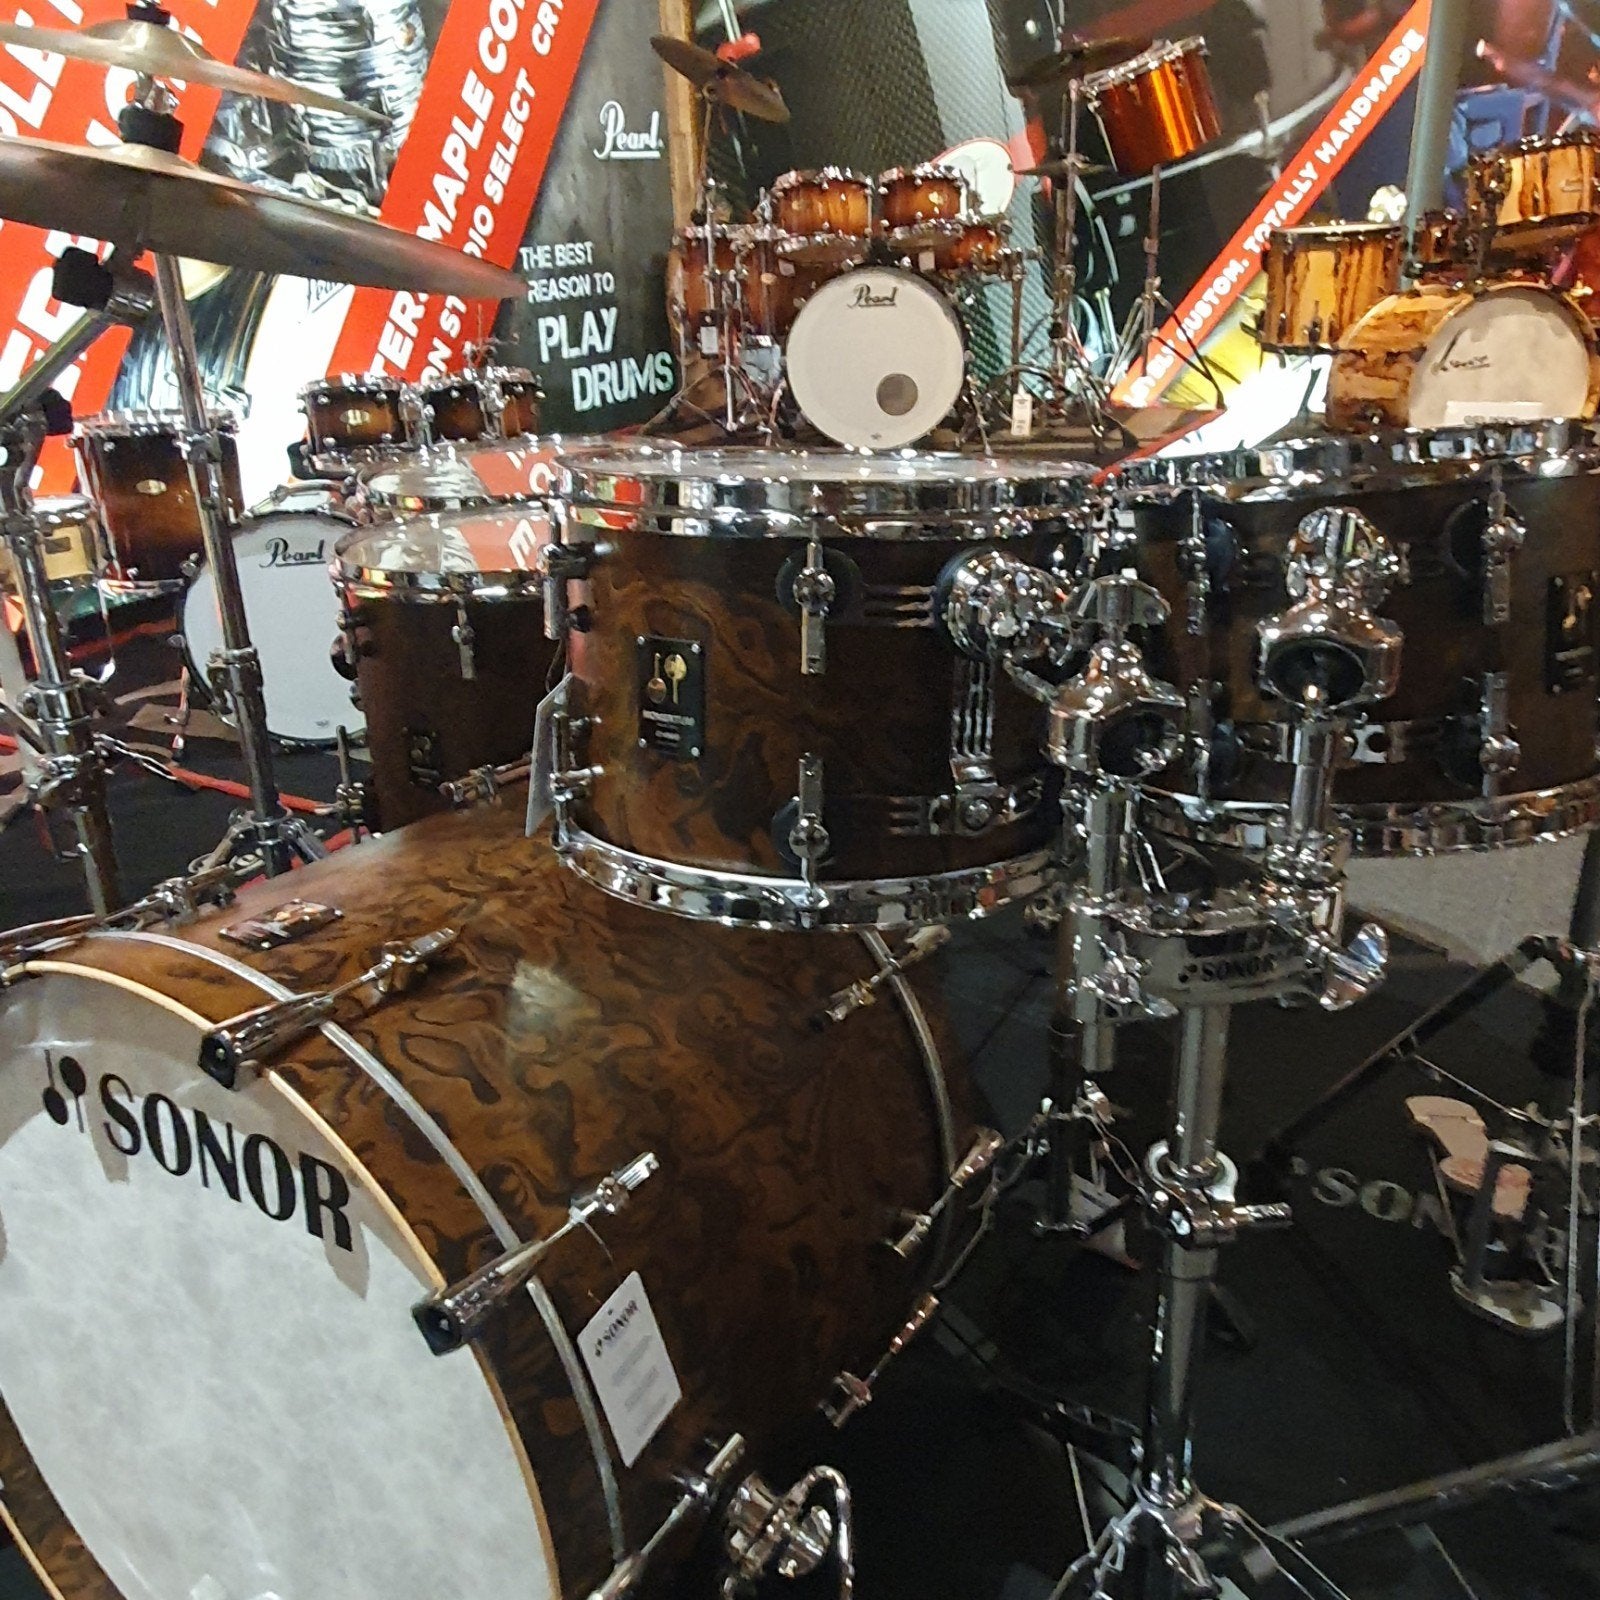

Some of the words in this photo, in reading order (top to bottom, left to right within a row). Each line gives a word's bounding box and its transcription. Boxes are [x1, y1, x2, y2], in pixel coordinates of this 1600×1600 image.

[416, 69, 495, 242] MAPLE
[478, 0, 526, 74] CO
[483, 67, 536, 205] SELECT
[531, 0, 565, 56] CR
[593, 100, 661, 160] Pearl
[1243, 160, 1319, 254] TOTALLY
[1314, 28, 1426, 165] HANDMADE
[519, 246, 554, 271] THE
[554, 240, 594, 268] BEST
[527, 273, 592, 304] REASON
[592, 270, 616, 295] TO
[846, 283, 899, 308] Pearl
[537, 306, 618, 364] PLAY
[571, 350, 675, 412] DRUMS
[258, 536, 327, 569] Pearl
[99, 1072, 354, 1253] SONOR
